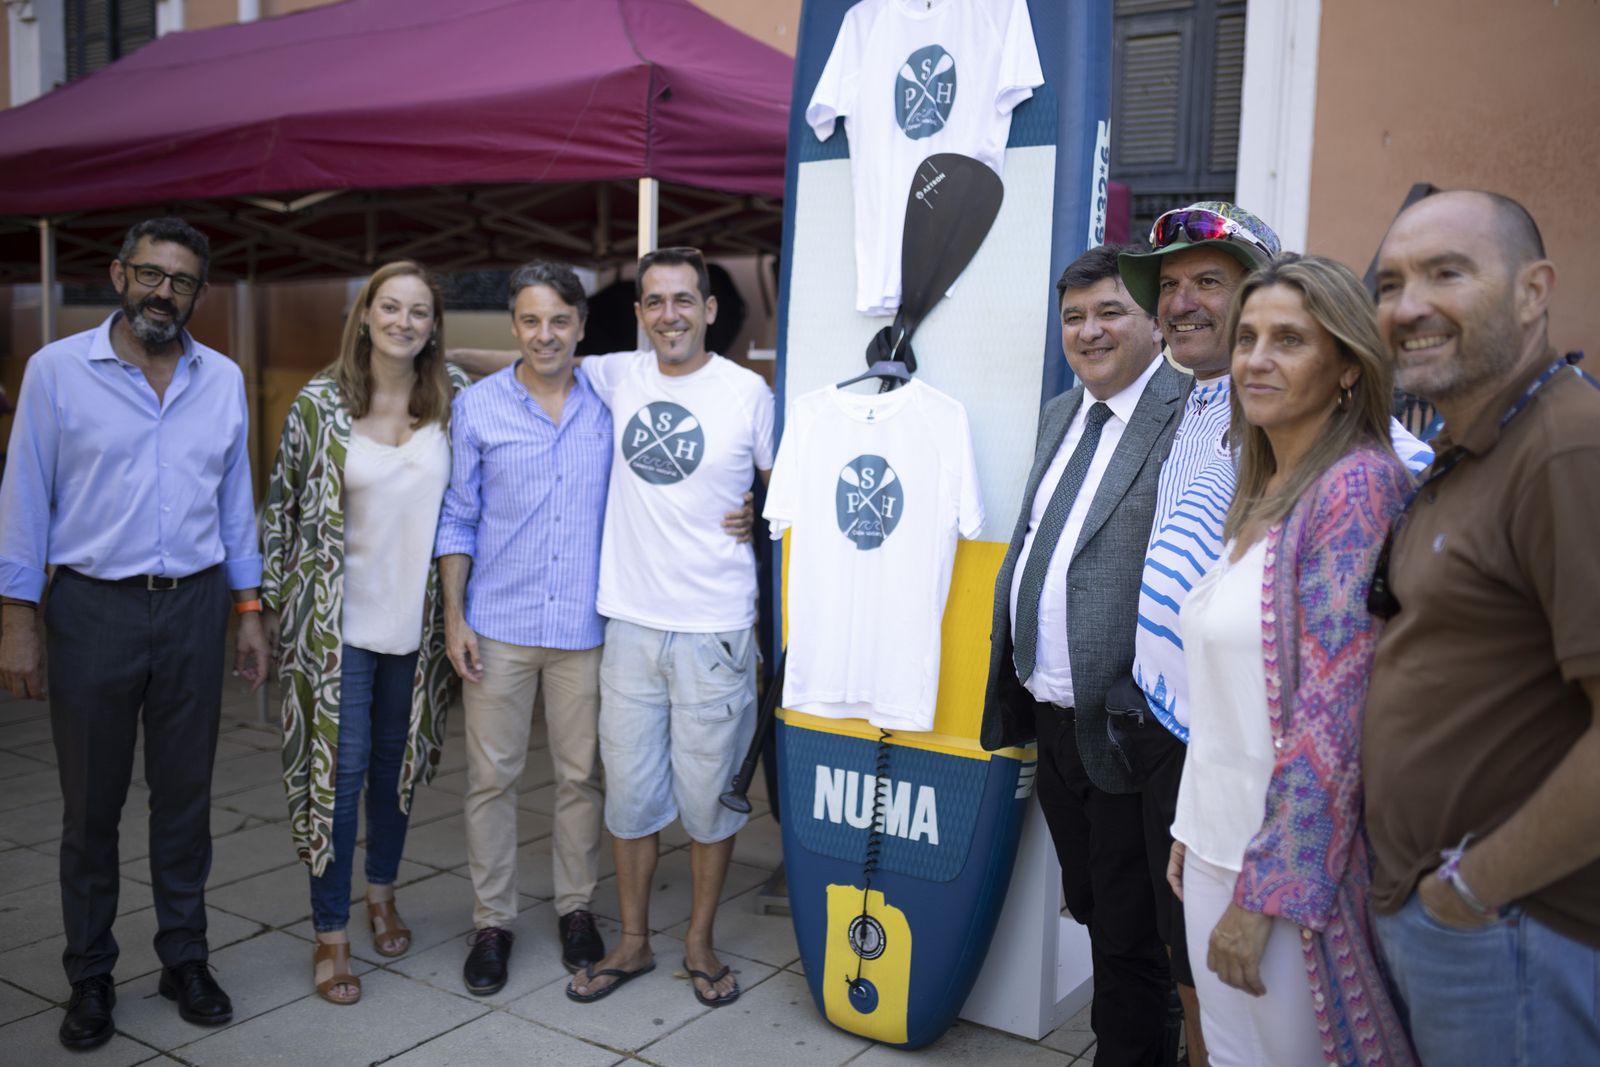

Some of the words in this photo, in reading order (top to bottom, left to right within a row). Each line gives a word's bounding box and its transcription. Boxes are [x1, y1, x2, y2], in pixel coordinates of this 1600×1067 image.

[656, 412, 673, 432] S
[631, 428, 649, 448] P
[674, 439, 698, 461] H
[860, 467, 875, 490] S
[813, 764, 939, 846] NUMA
